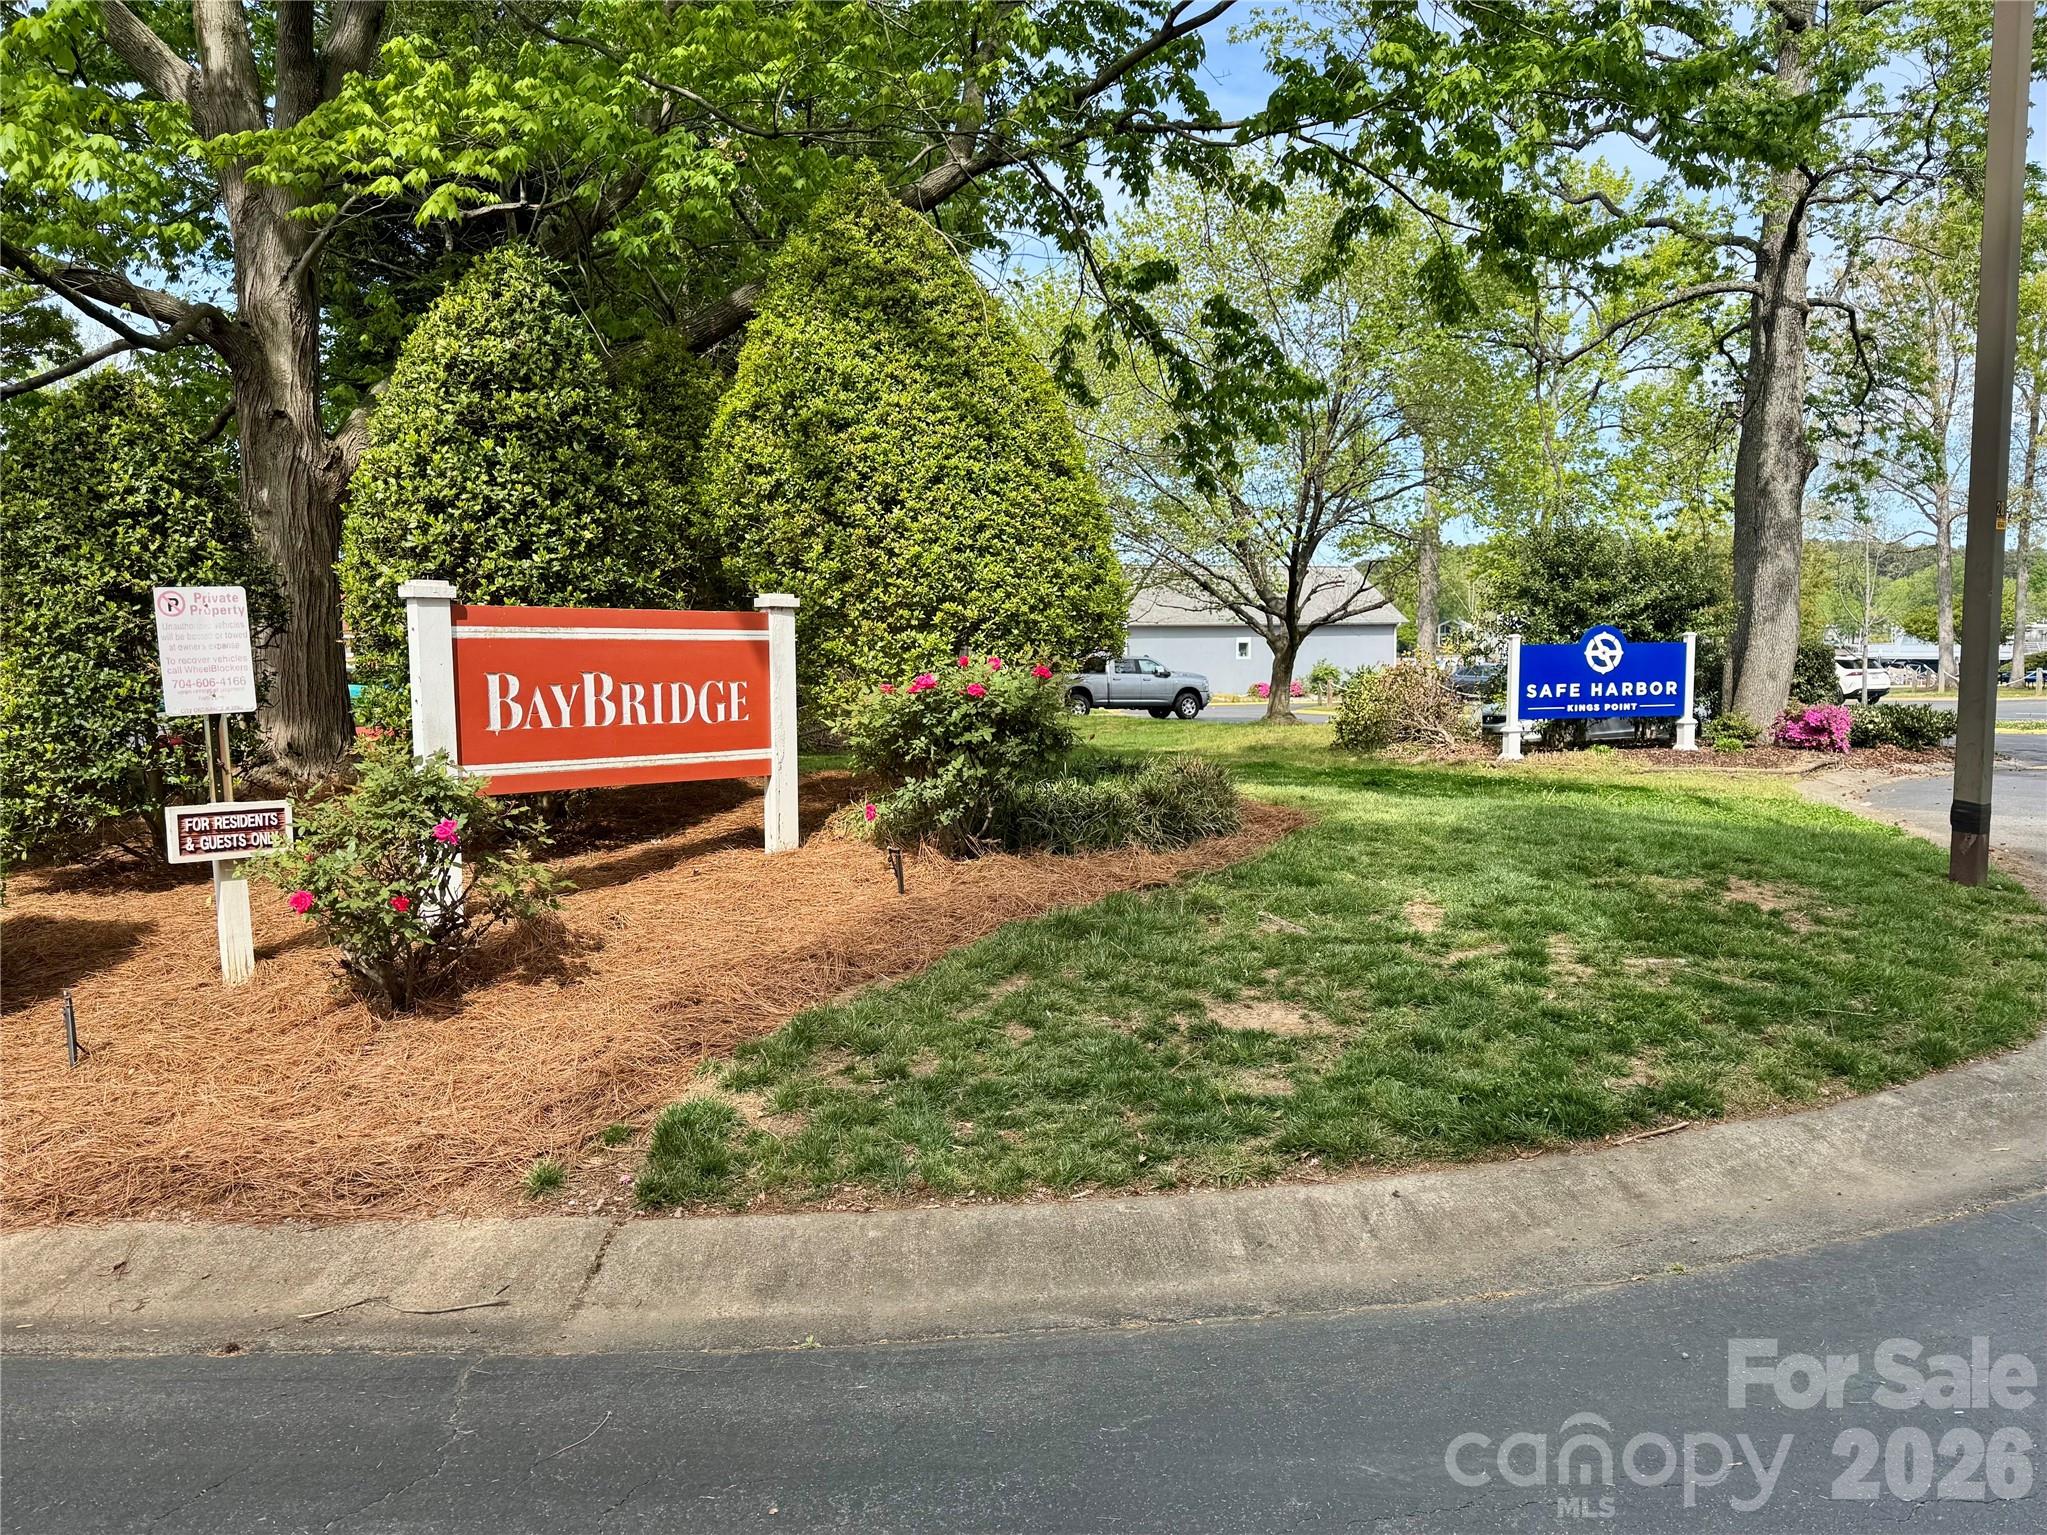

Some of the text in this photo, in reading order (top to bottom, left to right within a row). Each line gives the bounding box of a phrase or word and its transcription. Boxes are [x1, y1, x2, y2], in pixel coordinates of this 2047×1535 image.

[193, 592, 239, 604] Private
[190, 605, 245, 617] Property
[166, 657, 176, 665] To
[167, 666, 182, 674] call
[172, 676, 247, 689] 704-606-4166
[1526, 680, 1678, 698] SAFE HARBOR
[1566, 702, 1638, 712] KINGS POINT
[185, 812, 278, 832] FOR RESIDENTS
[185, 837, 195, 851] &
[200, 833, 247, 850] GUESTS
